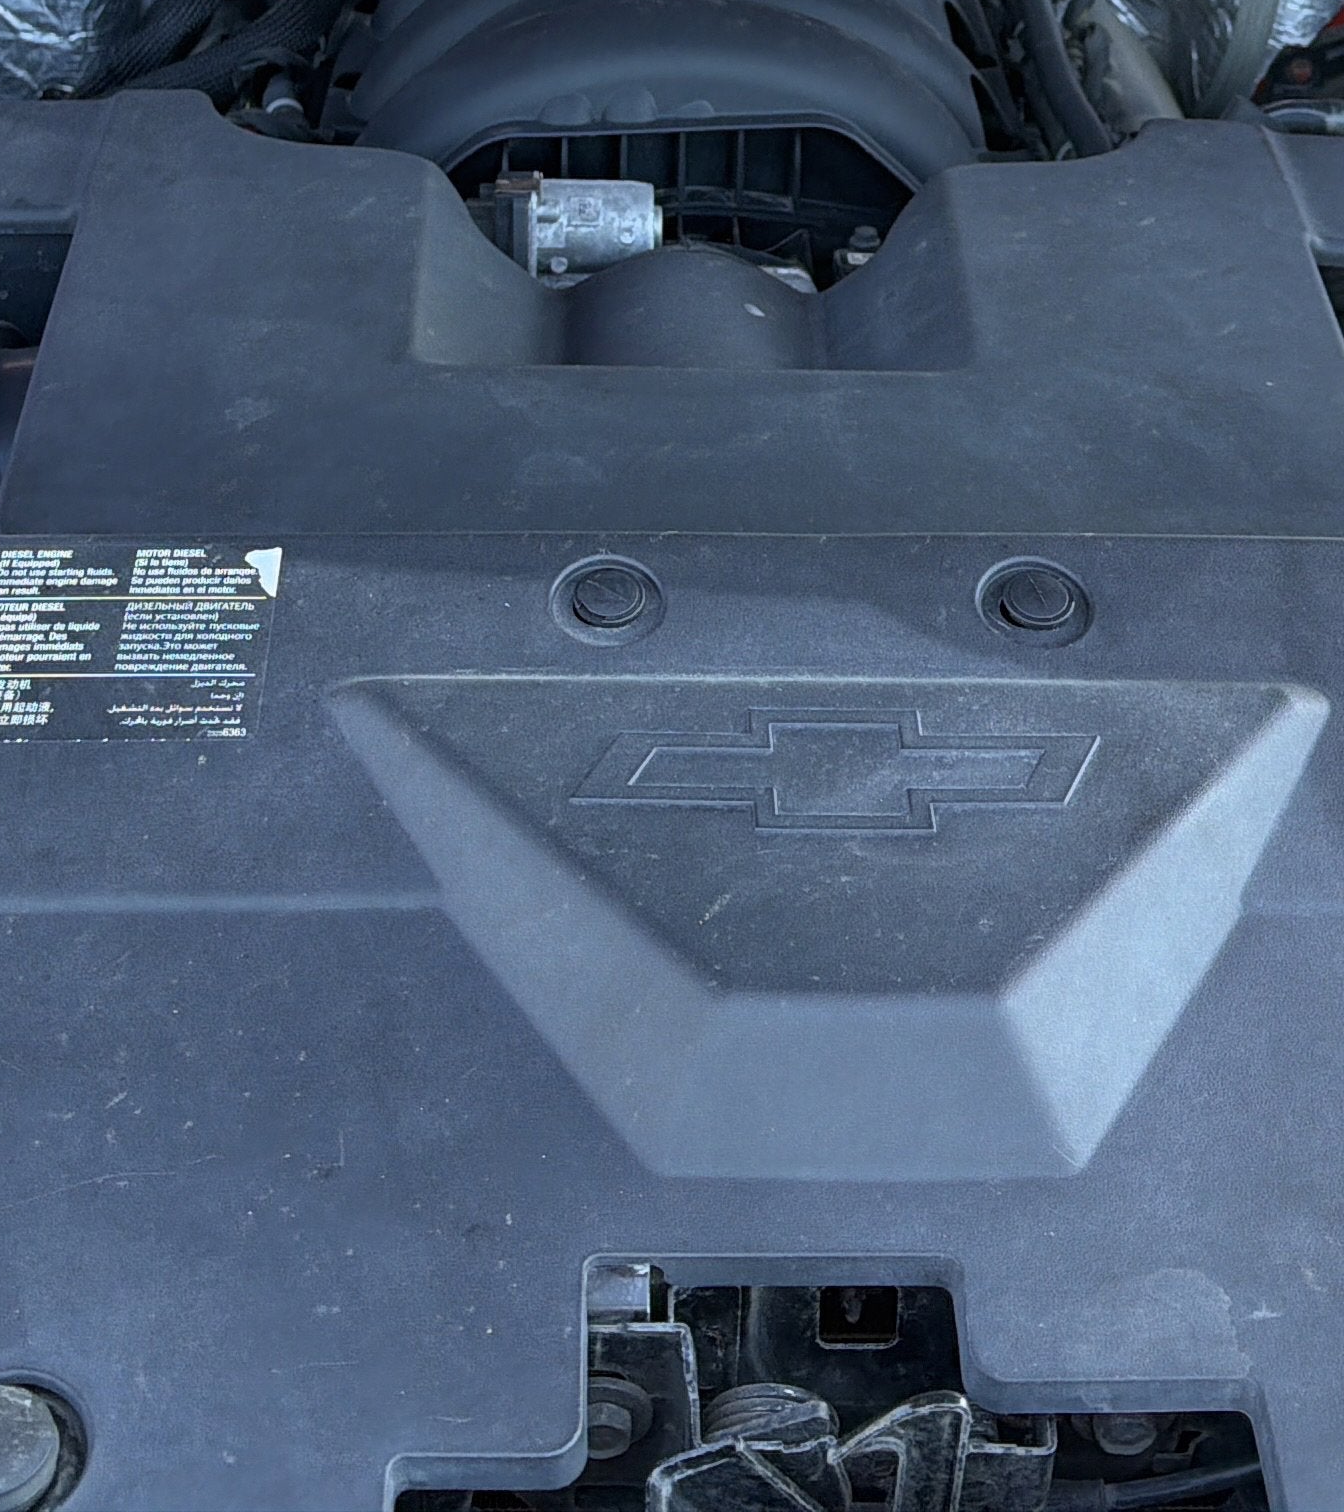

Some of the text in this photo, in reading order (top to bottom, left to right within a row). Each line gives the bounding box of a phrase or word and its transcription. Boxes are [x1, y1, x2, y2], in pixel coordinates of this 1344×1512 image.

[1, 550, 74, 559] DIESEL ENGINE
[136, 549, 208, 558] MOTOR DIESEL
[12, 559, 61, 569] Equipped)
[161, 558, 189, 568] tiene)
[11, 568, 28, 577] not
[29, 569, 47, 577] use
[48, 568, 85, 578] starting
[87, 568, 116, 577] fluids.
[133, 568, 146, 576] No
[147, 568, 165, 576] use
[167, 567, 198, 576] fluidos
[200, 567, 213, 576] de
[45, 578, 78, 588] engine
[80, 578, 119, 587] damage
[131, 577, 144, 585] Se
[145, 577, 181, 586] pueden
[182, 577, 222, 586] producir
[11, 587, 41, 596] result.
[31, 602, 66, 612] DIESEL
[125, 601, 255, 612] ДИЗЕЛЬНЫЙ ДВИГАТЕЛЬ
[0, 612, 37, 623] équipé)
[124, 612, 219, 623] (если установлен)
[18, 622, 51, 631] utiliser
[53, 622, 66, 631] de
[67, 622, 101, 633] liquide
[122, 621, 260, 632] Не используйте пусковые
[48, 632, 68, 641] Des
[174, 633, 194, 641] для
[33, 641, 85, 651] immédiats
[183, 643, 219, 651] может
[26, 652, 78, 663] pourraient
[79, 653, 92, 661] en
